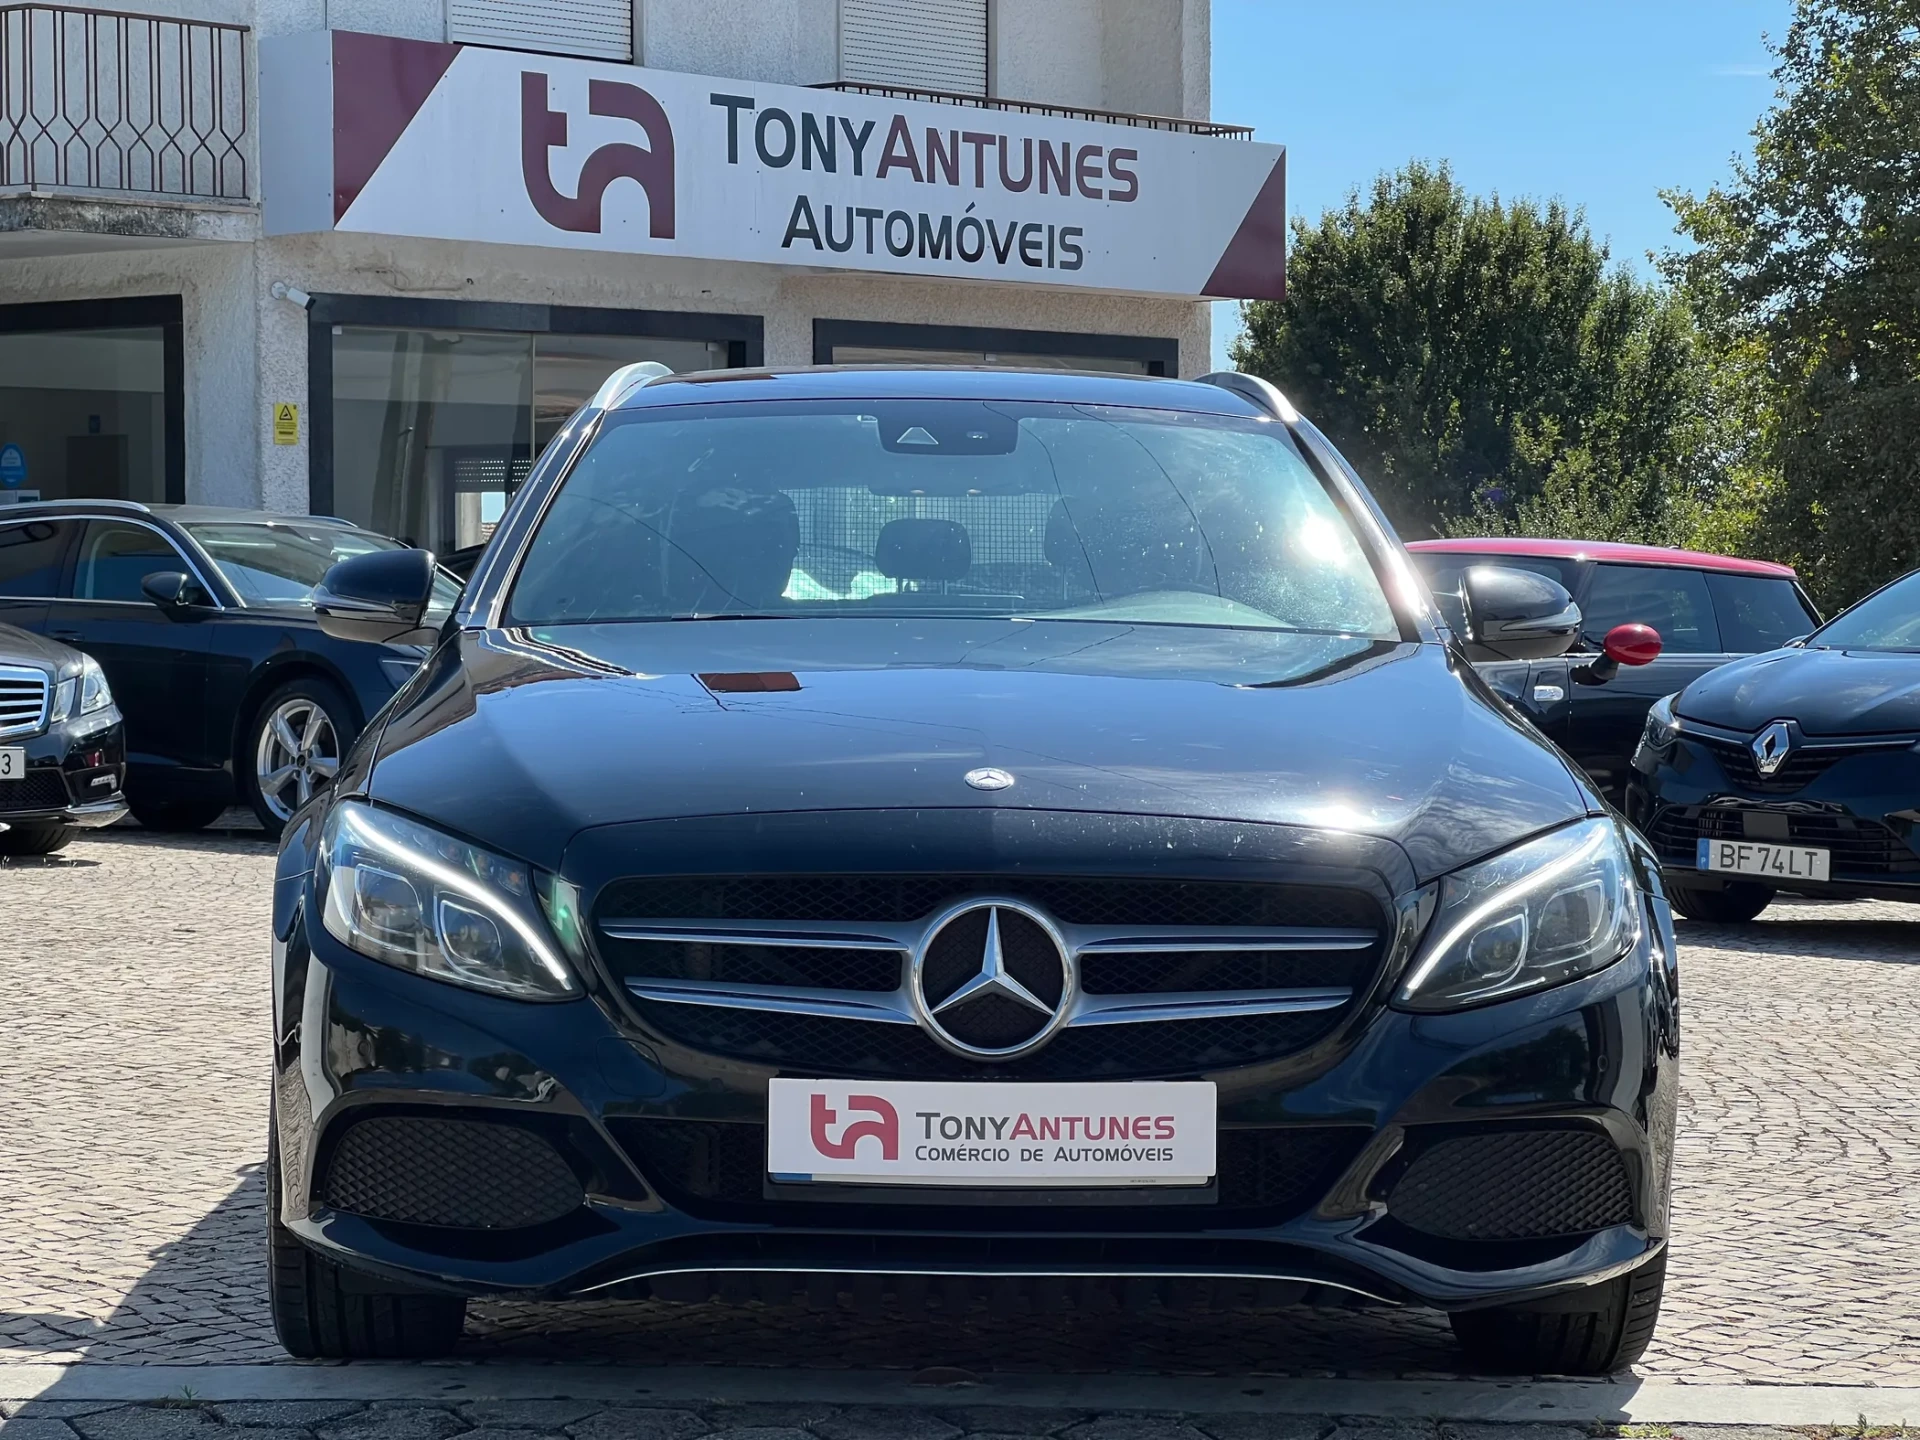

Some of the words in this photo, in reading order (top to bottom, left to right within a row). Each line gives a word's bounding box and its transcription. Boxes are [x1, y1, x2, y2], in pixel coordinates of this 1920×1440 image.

[781, 195, 1084, 271] AUTOMÓVEIS
[915, 1144, 1010, 1162] COMÉRCIO
[1020, 1148, 1043, 1162] DE
[1054, 1144, 1173, 1162] AUTOMÓVEIS
